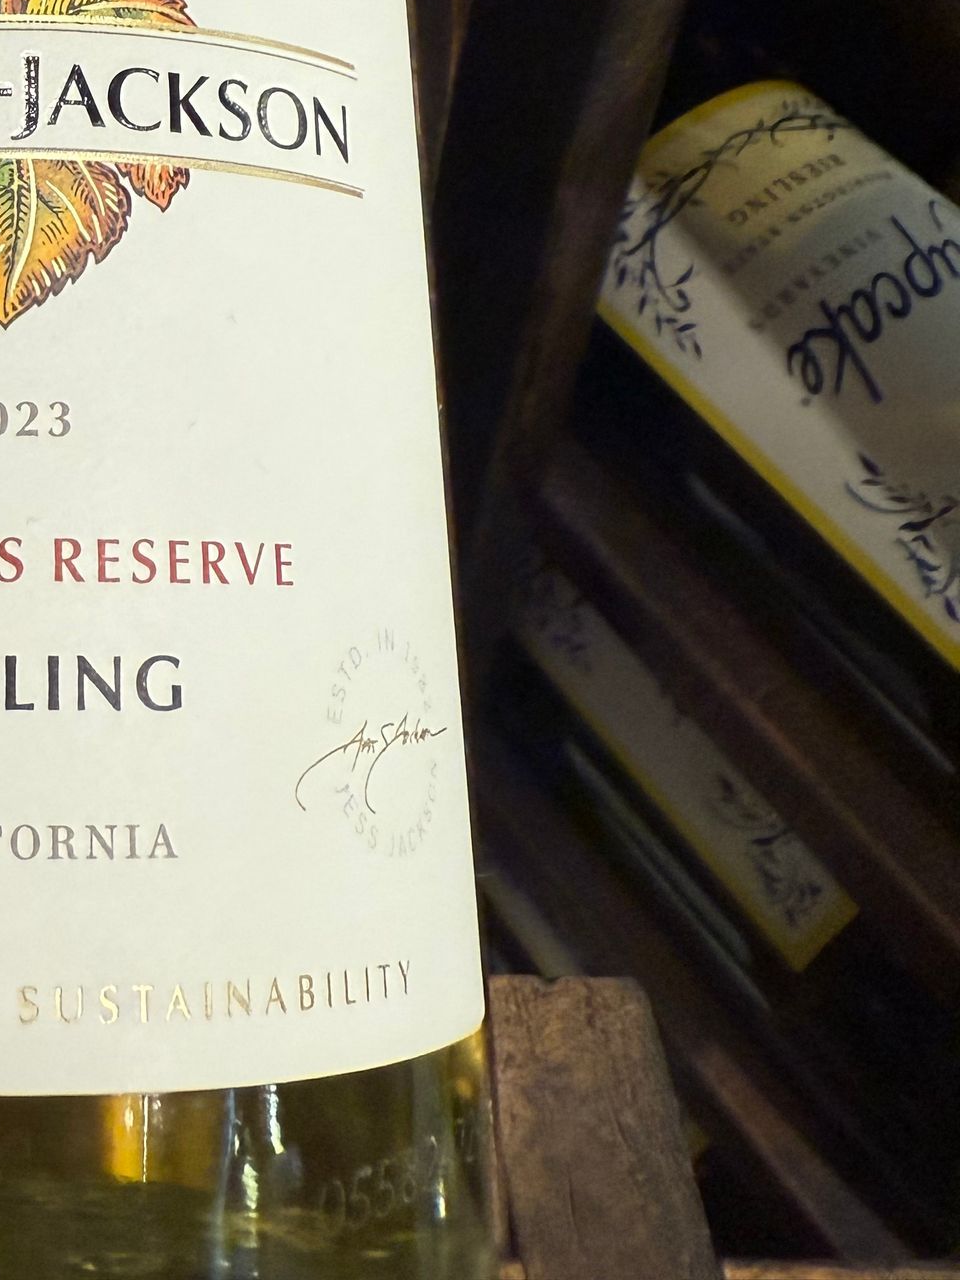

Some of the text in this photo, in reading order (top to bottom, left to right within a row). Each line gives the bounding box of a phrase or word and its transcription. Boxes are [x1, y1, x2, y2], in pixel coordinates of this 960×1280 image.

[787, 199, 960, 404] upcake
[53, 538, 295, 586] RESERVE
[16, 960, 411, 1025] SUSTAINABILITY
